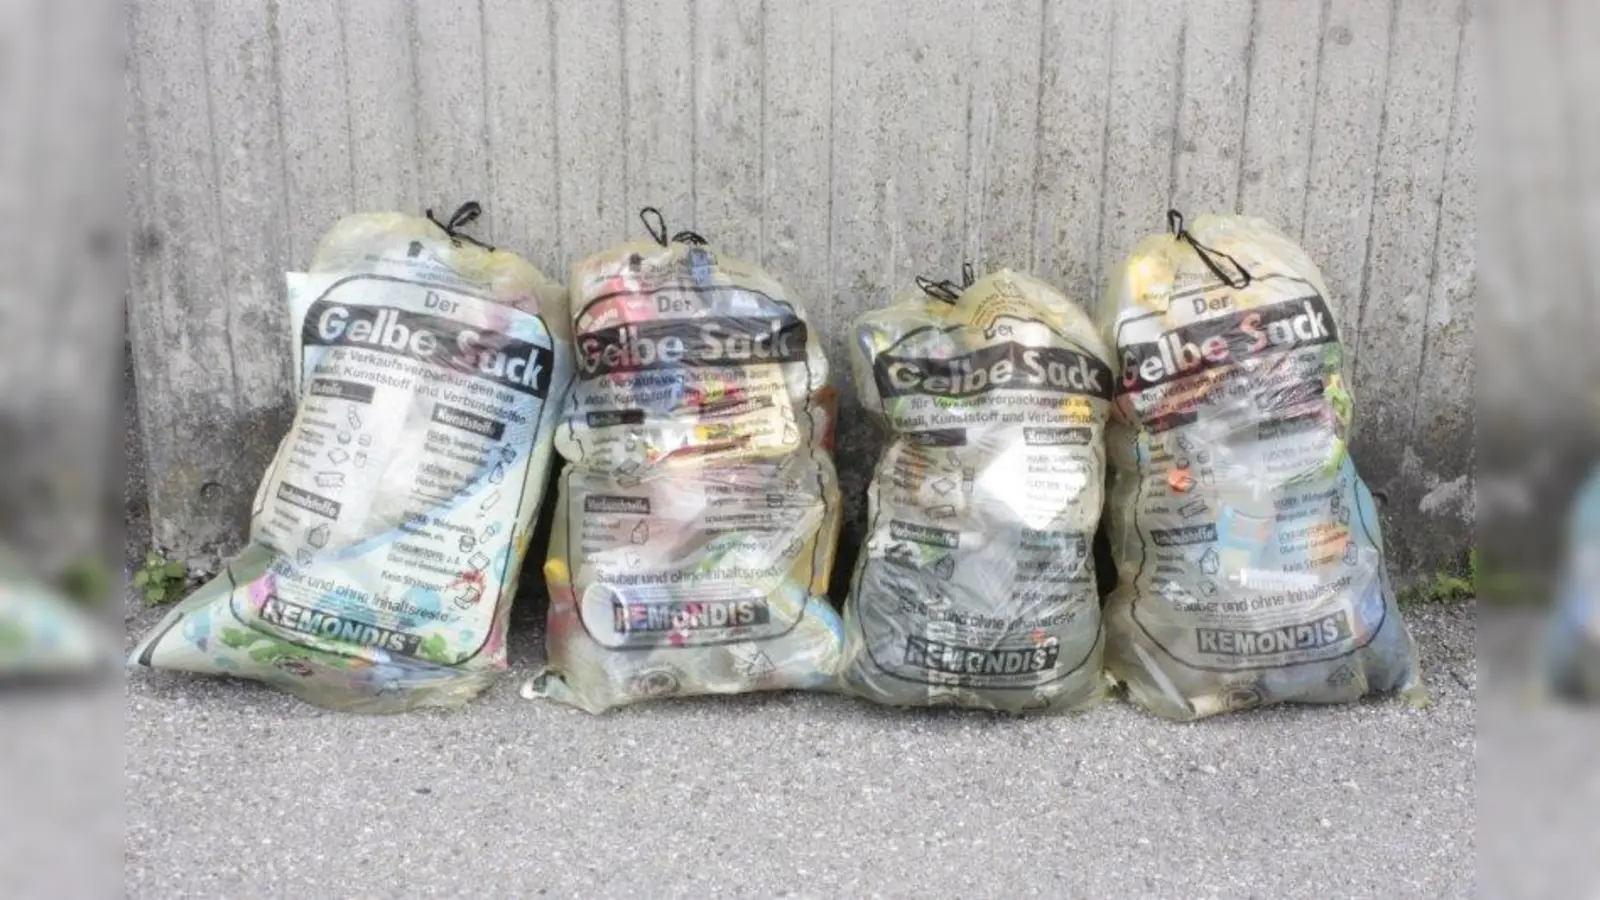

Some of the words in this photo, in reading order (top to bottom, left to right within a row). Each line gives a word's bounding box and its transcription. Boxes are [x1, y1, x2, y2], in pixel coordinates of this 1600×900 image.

[424, 290, 460, 314] Der
[1193, 295, 1230, 315] Der
[318, 306, 437, 356] Gelbe
[452, 329, 543, 390] Sack
[581, 323, 684, 374] Gelbe
[700, 319, 794, 361] Sack
[1123, 333, 1229, 389] Gelbe
[1240, 301, 1329, 353] Sack
[887, 358, 1014, 394] Gelbe
[1022, 350, 1102, 392] Sack
[414, 383, 440, 397] und
[1002, 411, 1025, 423] und
[308, 575, 335, 592] und
[336, 583, 369, 602] ohne
[597, 569, 640, 585] Sauber
[641, 567, 668, 583] und
[1222, 598, 1249, 613] und
[1251, 594, 1285, 611] ohne
[260, 598, 407, 651] REMONDIS
[1201, 616, 1339, 655] REMONDIS
[907, 637, 1048, 675] REMONDIS
